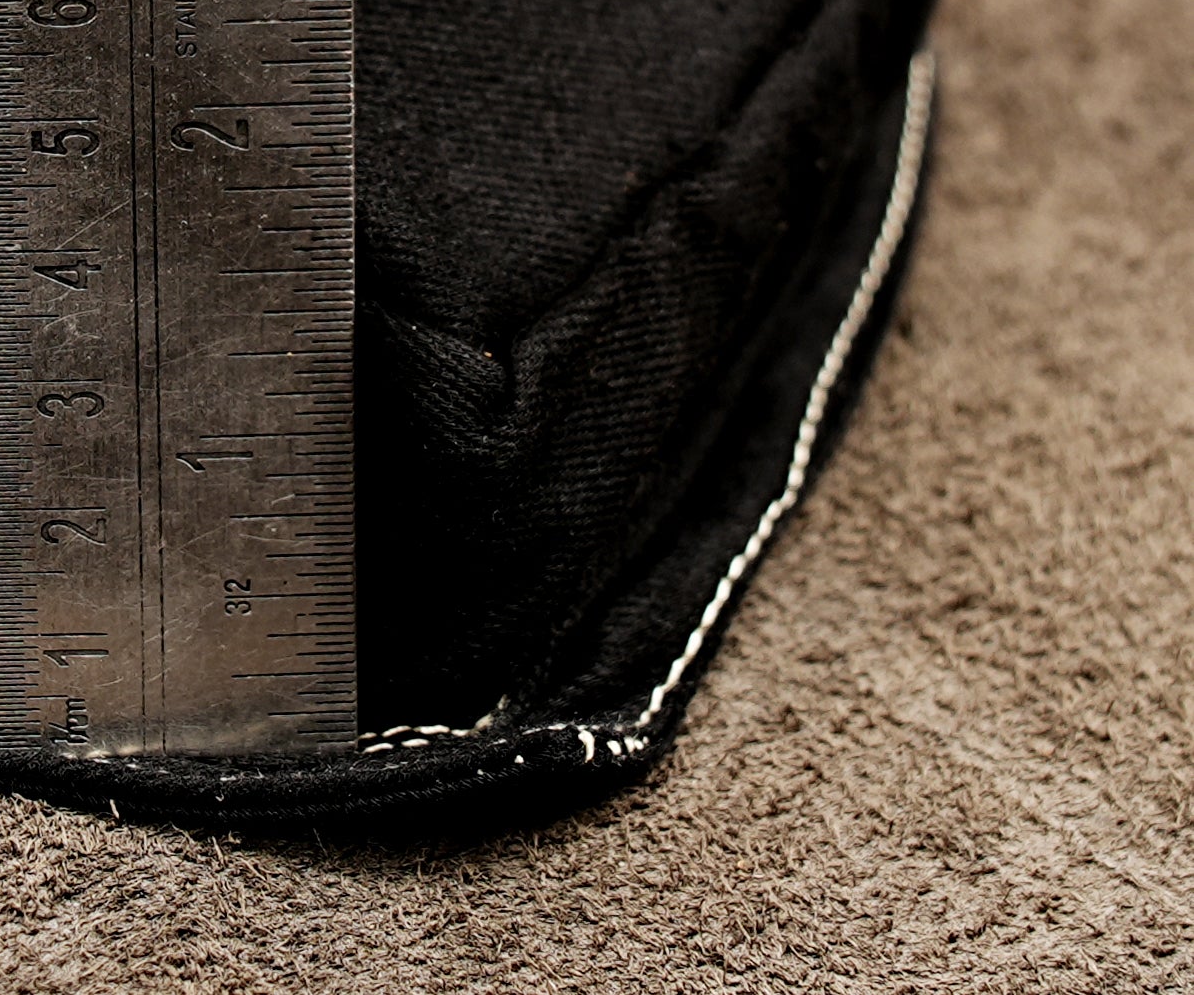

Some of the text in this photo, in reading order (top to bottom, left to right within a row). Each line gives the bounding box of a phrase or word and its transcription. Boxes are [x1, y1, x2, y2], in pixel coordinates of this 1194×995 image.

[31, 127, 101, 158] 5
[170, 119, 250, 152] 2
[33, 259, 102, 291] 4
[37, 391, 104, 419] 3
[176, 450, 254, 472] 1
[40, 518, 107, 546] 2
[224, 578, 252, 616] 32
[43, 649, 109, 668] 1
